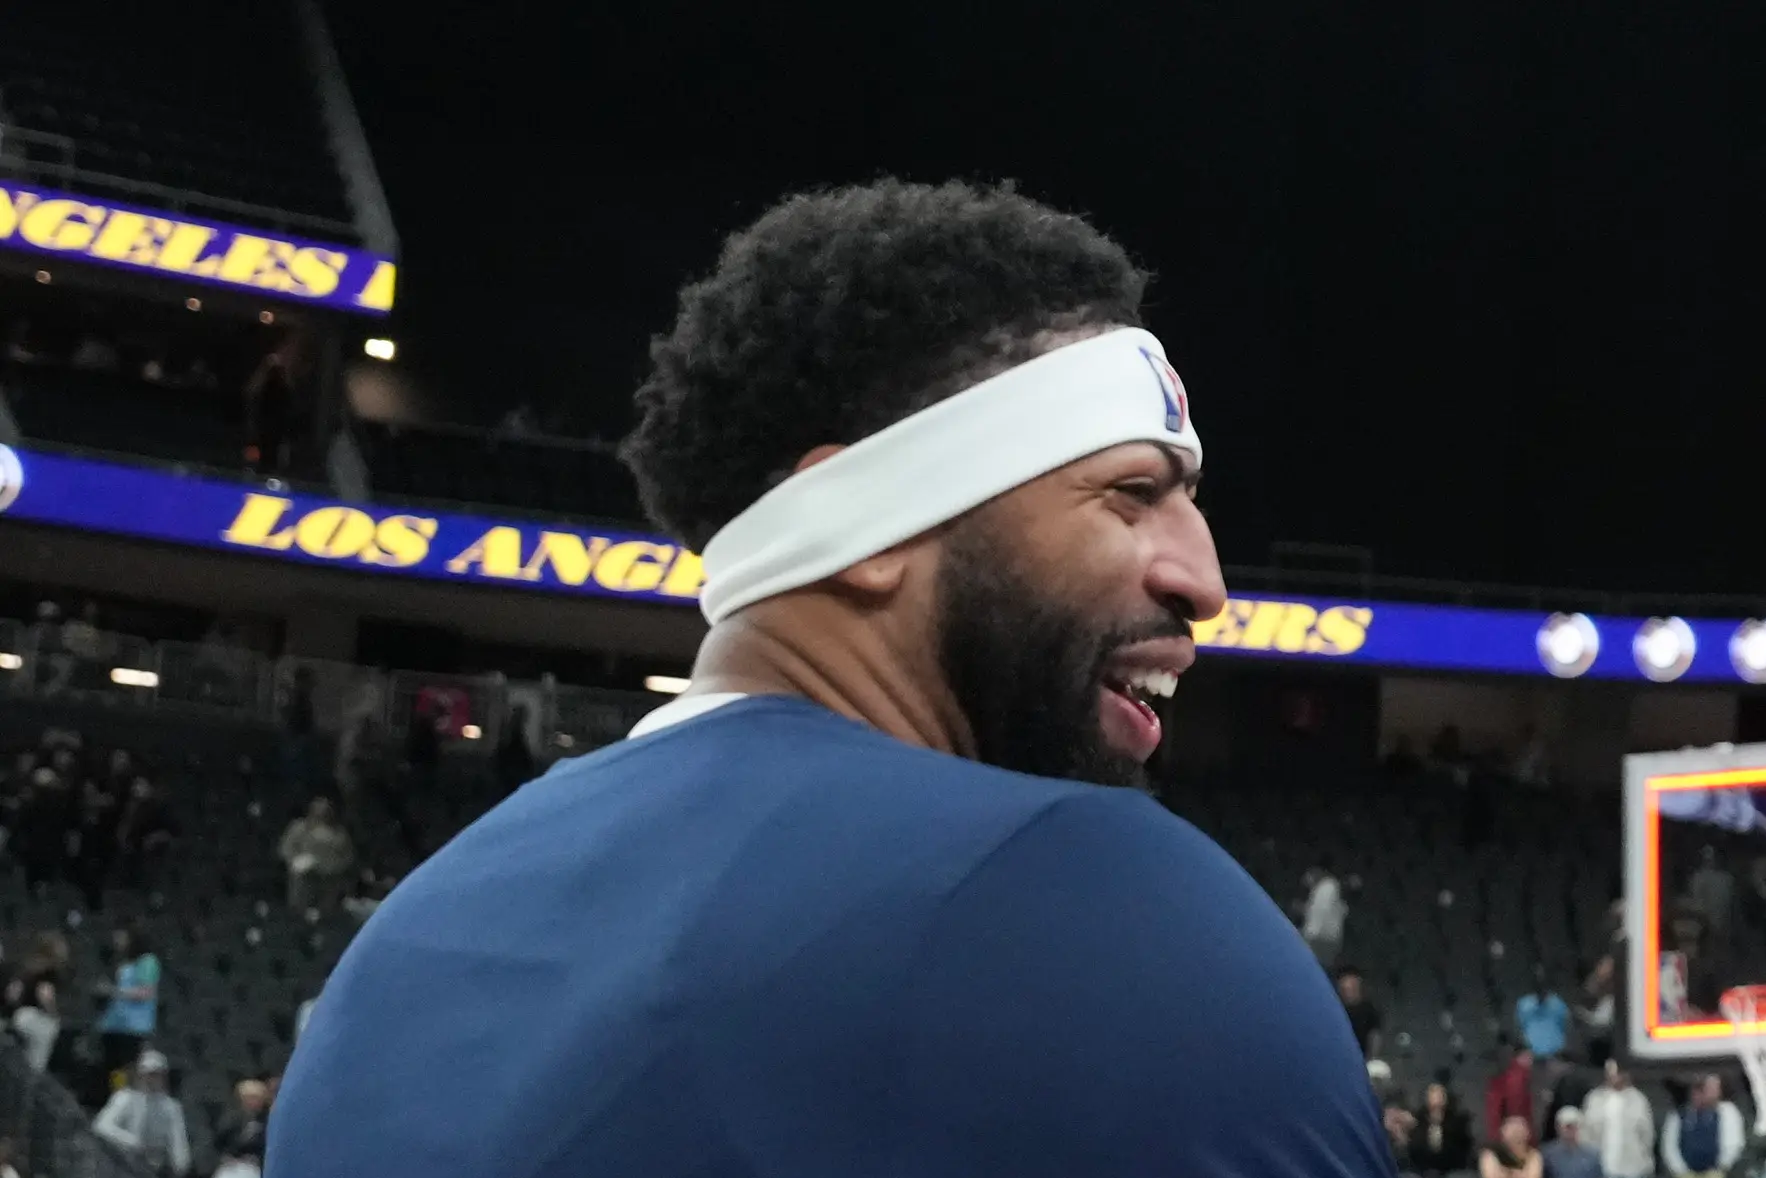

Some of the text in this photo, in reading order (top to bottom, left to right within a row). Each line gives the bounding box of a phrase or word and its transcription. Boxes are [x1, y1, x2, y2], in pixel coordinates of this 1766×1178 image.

[0, 186, 348, 298] NGELES
[220, 492, 1373, 656] LOS ANGE ERS
